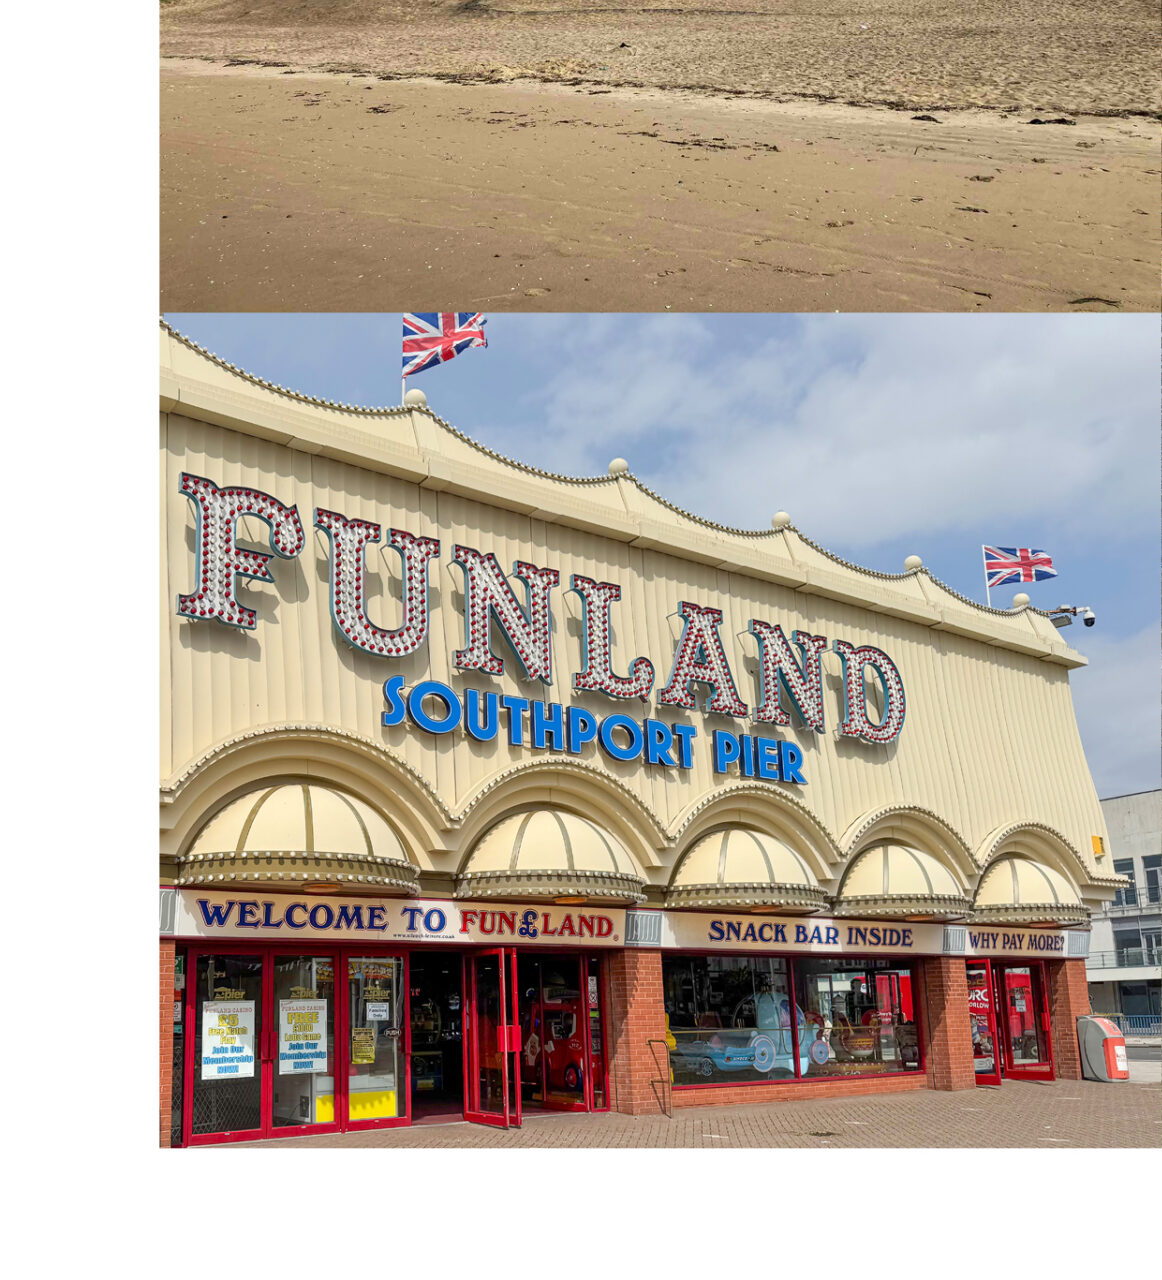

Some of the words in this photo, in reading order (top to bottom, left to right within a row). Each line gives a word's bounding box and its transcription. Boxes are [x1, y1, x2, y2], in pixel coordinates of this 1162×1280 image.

[176, 472, 906, 744] FUNLAND
[381, 675, 697, 769] SOUTHPORT
[712, 729, 808, 785] PIER
[196, 899, 389, 931] WELCOME
[402, 907, 447, 933] TO
[709, 920, 788, 943] SNACK
[794, 924, 839, 945] BAR
[846, 926, 913, 947] INSIDE
[969, 931, 999, 949] WHY
[1002, 933, 1025, 949] PAY
[1027, 934, 1065, 951] MORE?
[287, 1012, 319, 1024] FREE
